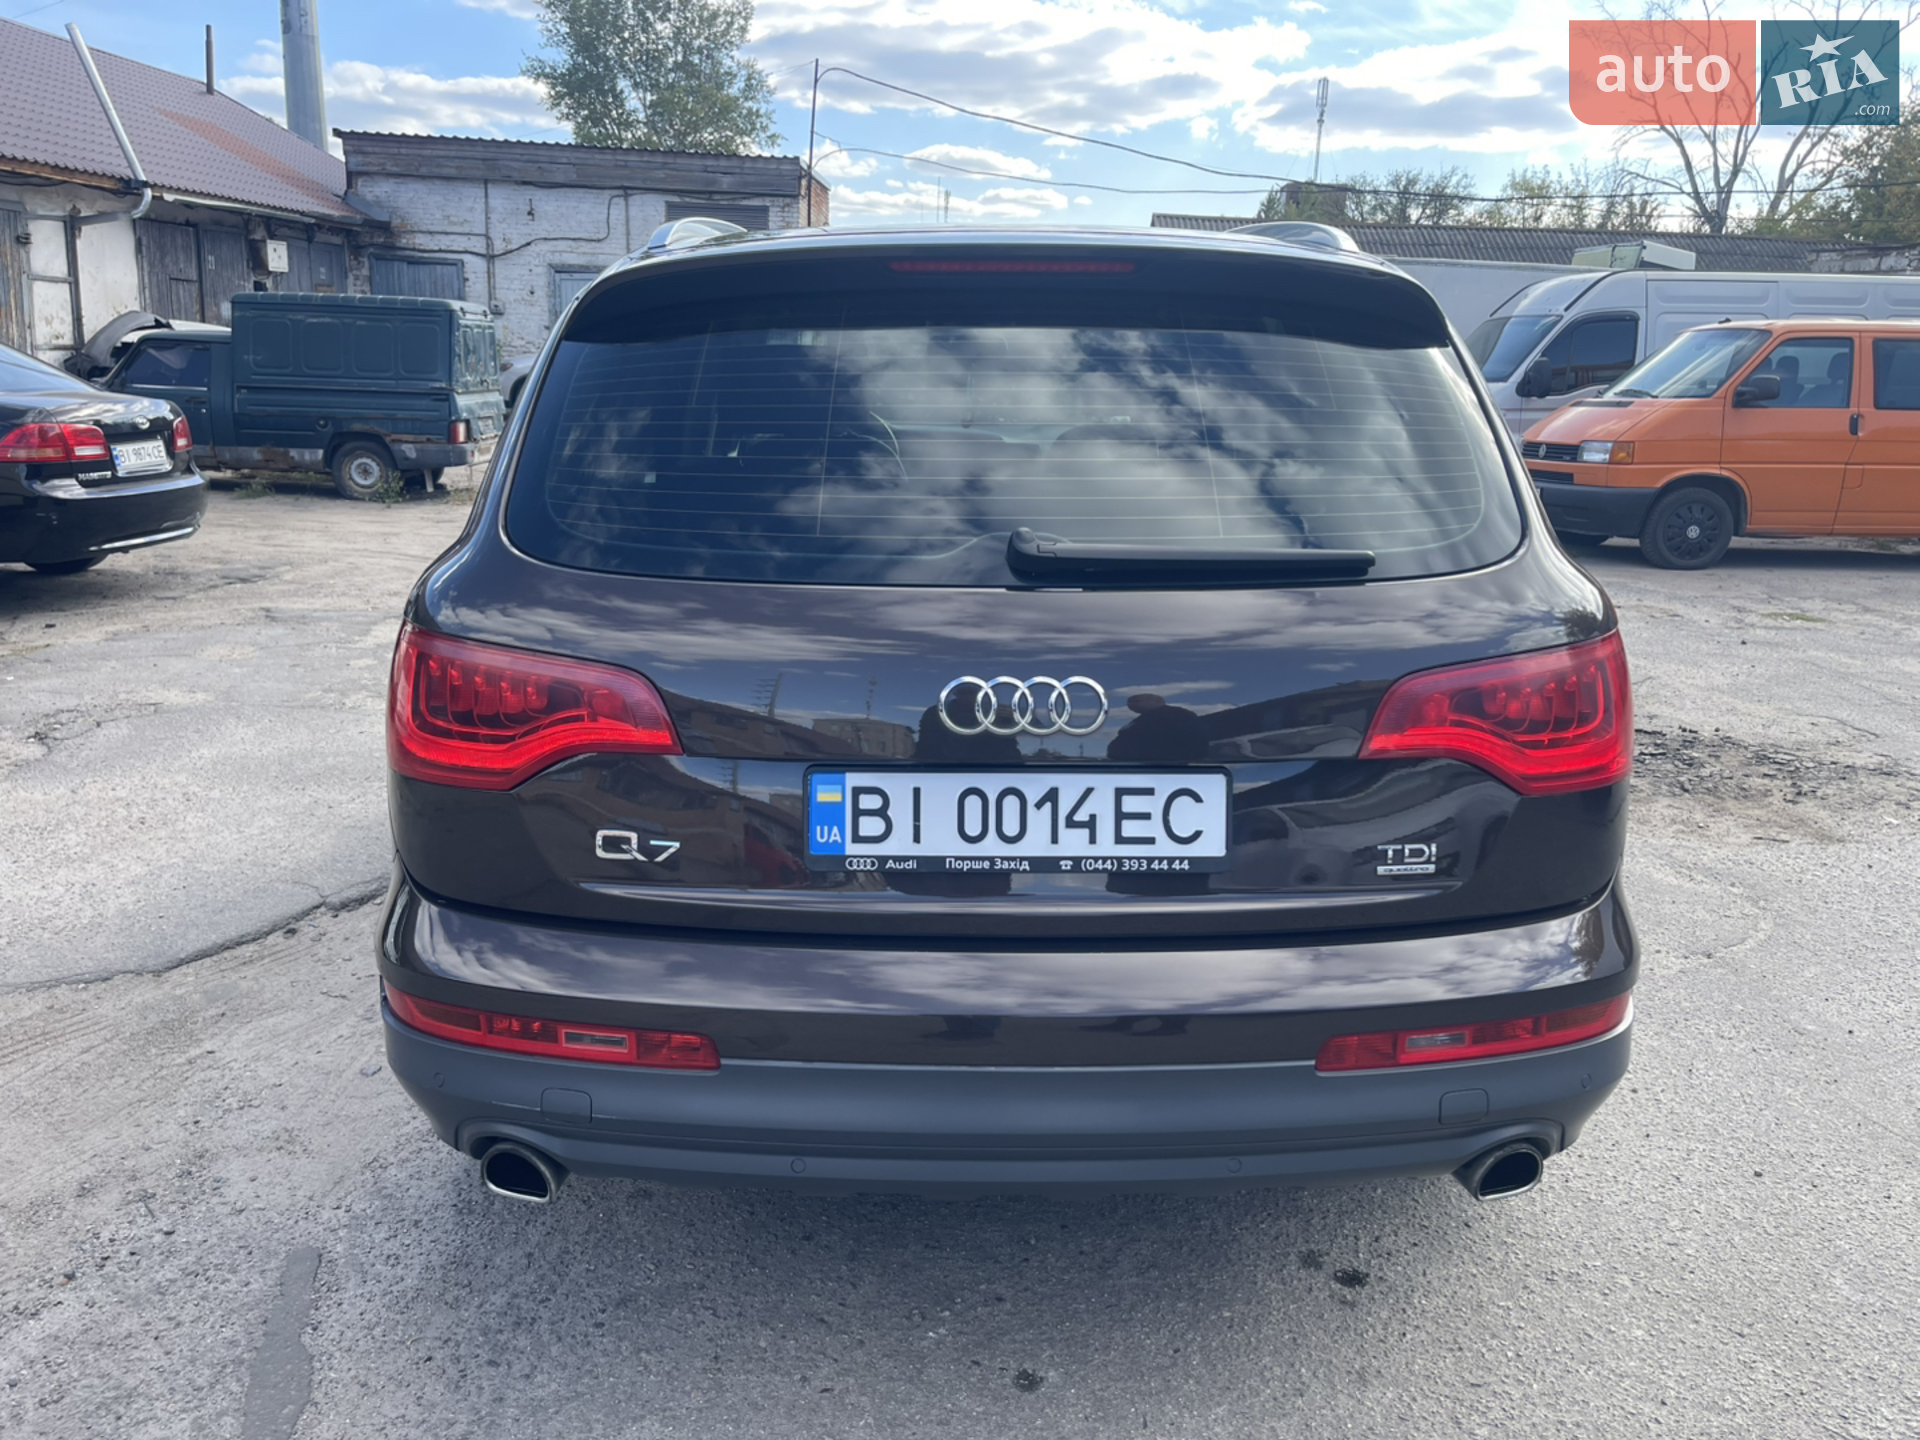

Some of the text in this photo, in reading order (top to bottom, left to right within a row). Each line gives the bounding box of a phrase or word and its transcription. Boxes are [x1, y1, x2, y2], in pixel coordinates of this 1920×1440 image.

[816, 825, 842, 843] UA
[595, 829, 680, 862] Q7
[1377, 843, 1437, 864] TDI
[885, 859, 917, 869] Audi
[945, 858, 1030, 871] Порше Захід
[1080, 859, 1190, 872] (044) 393 44 44
